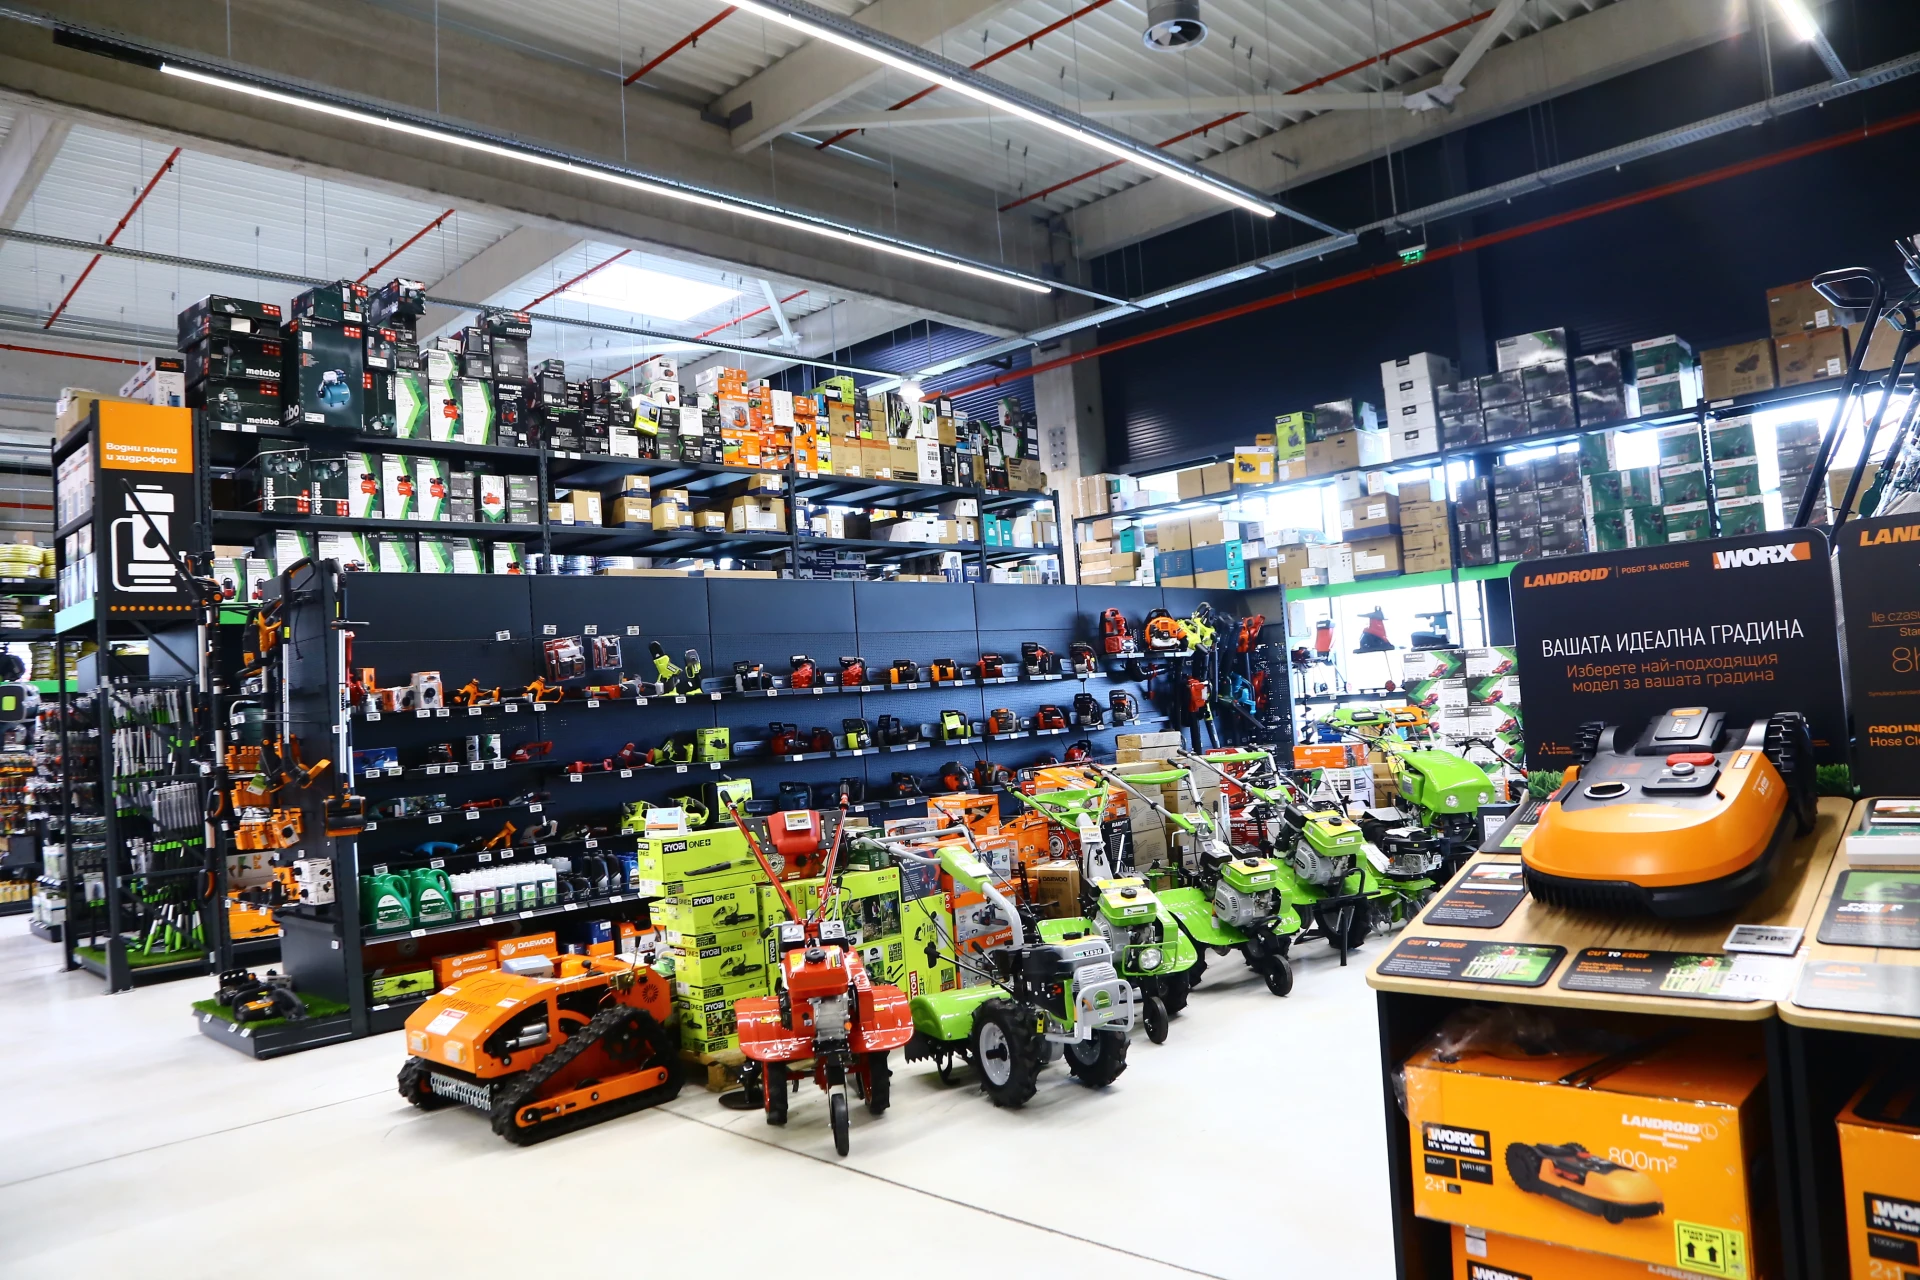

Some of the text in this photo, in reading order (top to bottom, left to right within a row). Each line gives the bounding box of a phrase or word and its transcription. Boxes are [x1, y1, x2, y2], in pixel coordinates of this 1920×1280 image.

[506, 326, 531, 335] metabo
[246, 367, 281, 378] metabo
[498, 383, 522, 391] RAIDER
[247, 416, 280, 426] metabo
[1276, 416, 1292, 424] RYOBI
[143, 446, 178, 455] помпи
[106, 453, 177, 465] и хидрофори
[266, 477, 274, 511] metabo
[313, 481, 321, 515] metabo
[1714, 543, 1798, 569] WORX
[1621, 560, 1690, 574] РОБОТ ЗА КОСЕНЕ
[1523, 567, 1610, 588] LANDROID
[1542, 618, 1805, 658] ВАШАТА ИДЕАЛНА ГРАДИНА
[1567, 653, 1779, 679] Изберете най-подходящия
[1572, 669, 1775, 693] модел за вашата градина
[1869, 736, 1902, 747] Hose
[663, 842, 686, 853] RYOBI
[693, 896, 713, 906] RYOBI
[517, 937, 554, 949] DAEWOO
[1407, 939, 1427, 947] CUT
[462, 953, 487, 963] DAEWOO
[700, 947, 720, 958] RYOBI
[463, 964, 488, 974] DAEWOO
[704, 1001, 725, 1012] RYOBI
[1621, 1114, 1700, 1135] LANDROID
[1429, 1127, 1479, 1148] WORX
[1441, 1143, 1459, 1151] your
[1460, 1146, 1486, 1156] nature
[1424, 1175, 1447, 1193] 2+1
